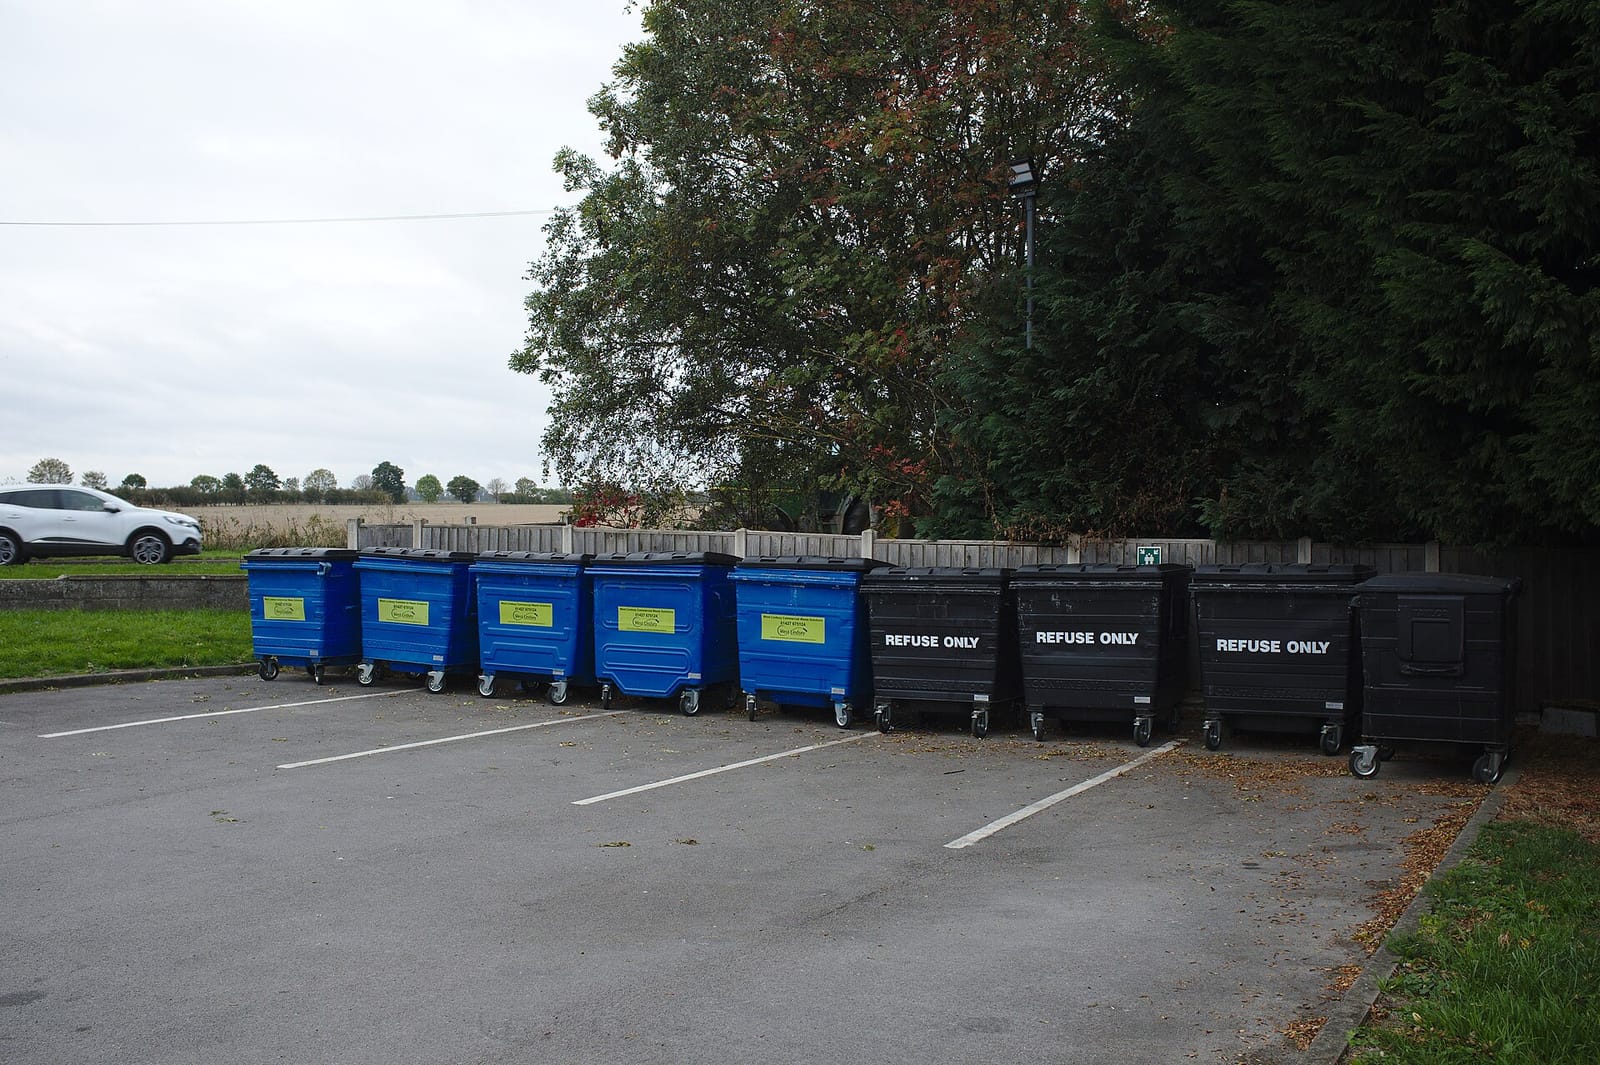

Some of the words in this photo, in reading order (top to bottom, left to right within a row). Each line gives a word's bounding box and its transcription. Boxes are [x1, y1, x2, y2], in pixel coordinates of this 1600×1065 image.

[885, 634, 939, 648] REFUSE
[944, 636, 980, 649] ONLY
[1036, 631, 1094, 644] REFUSE
[1100, 632, 1139, 646] ONLY
[1216, 639, 1280, 653] REFUSE
[1287, 640, 1330, 654] ONLY
